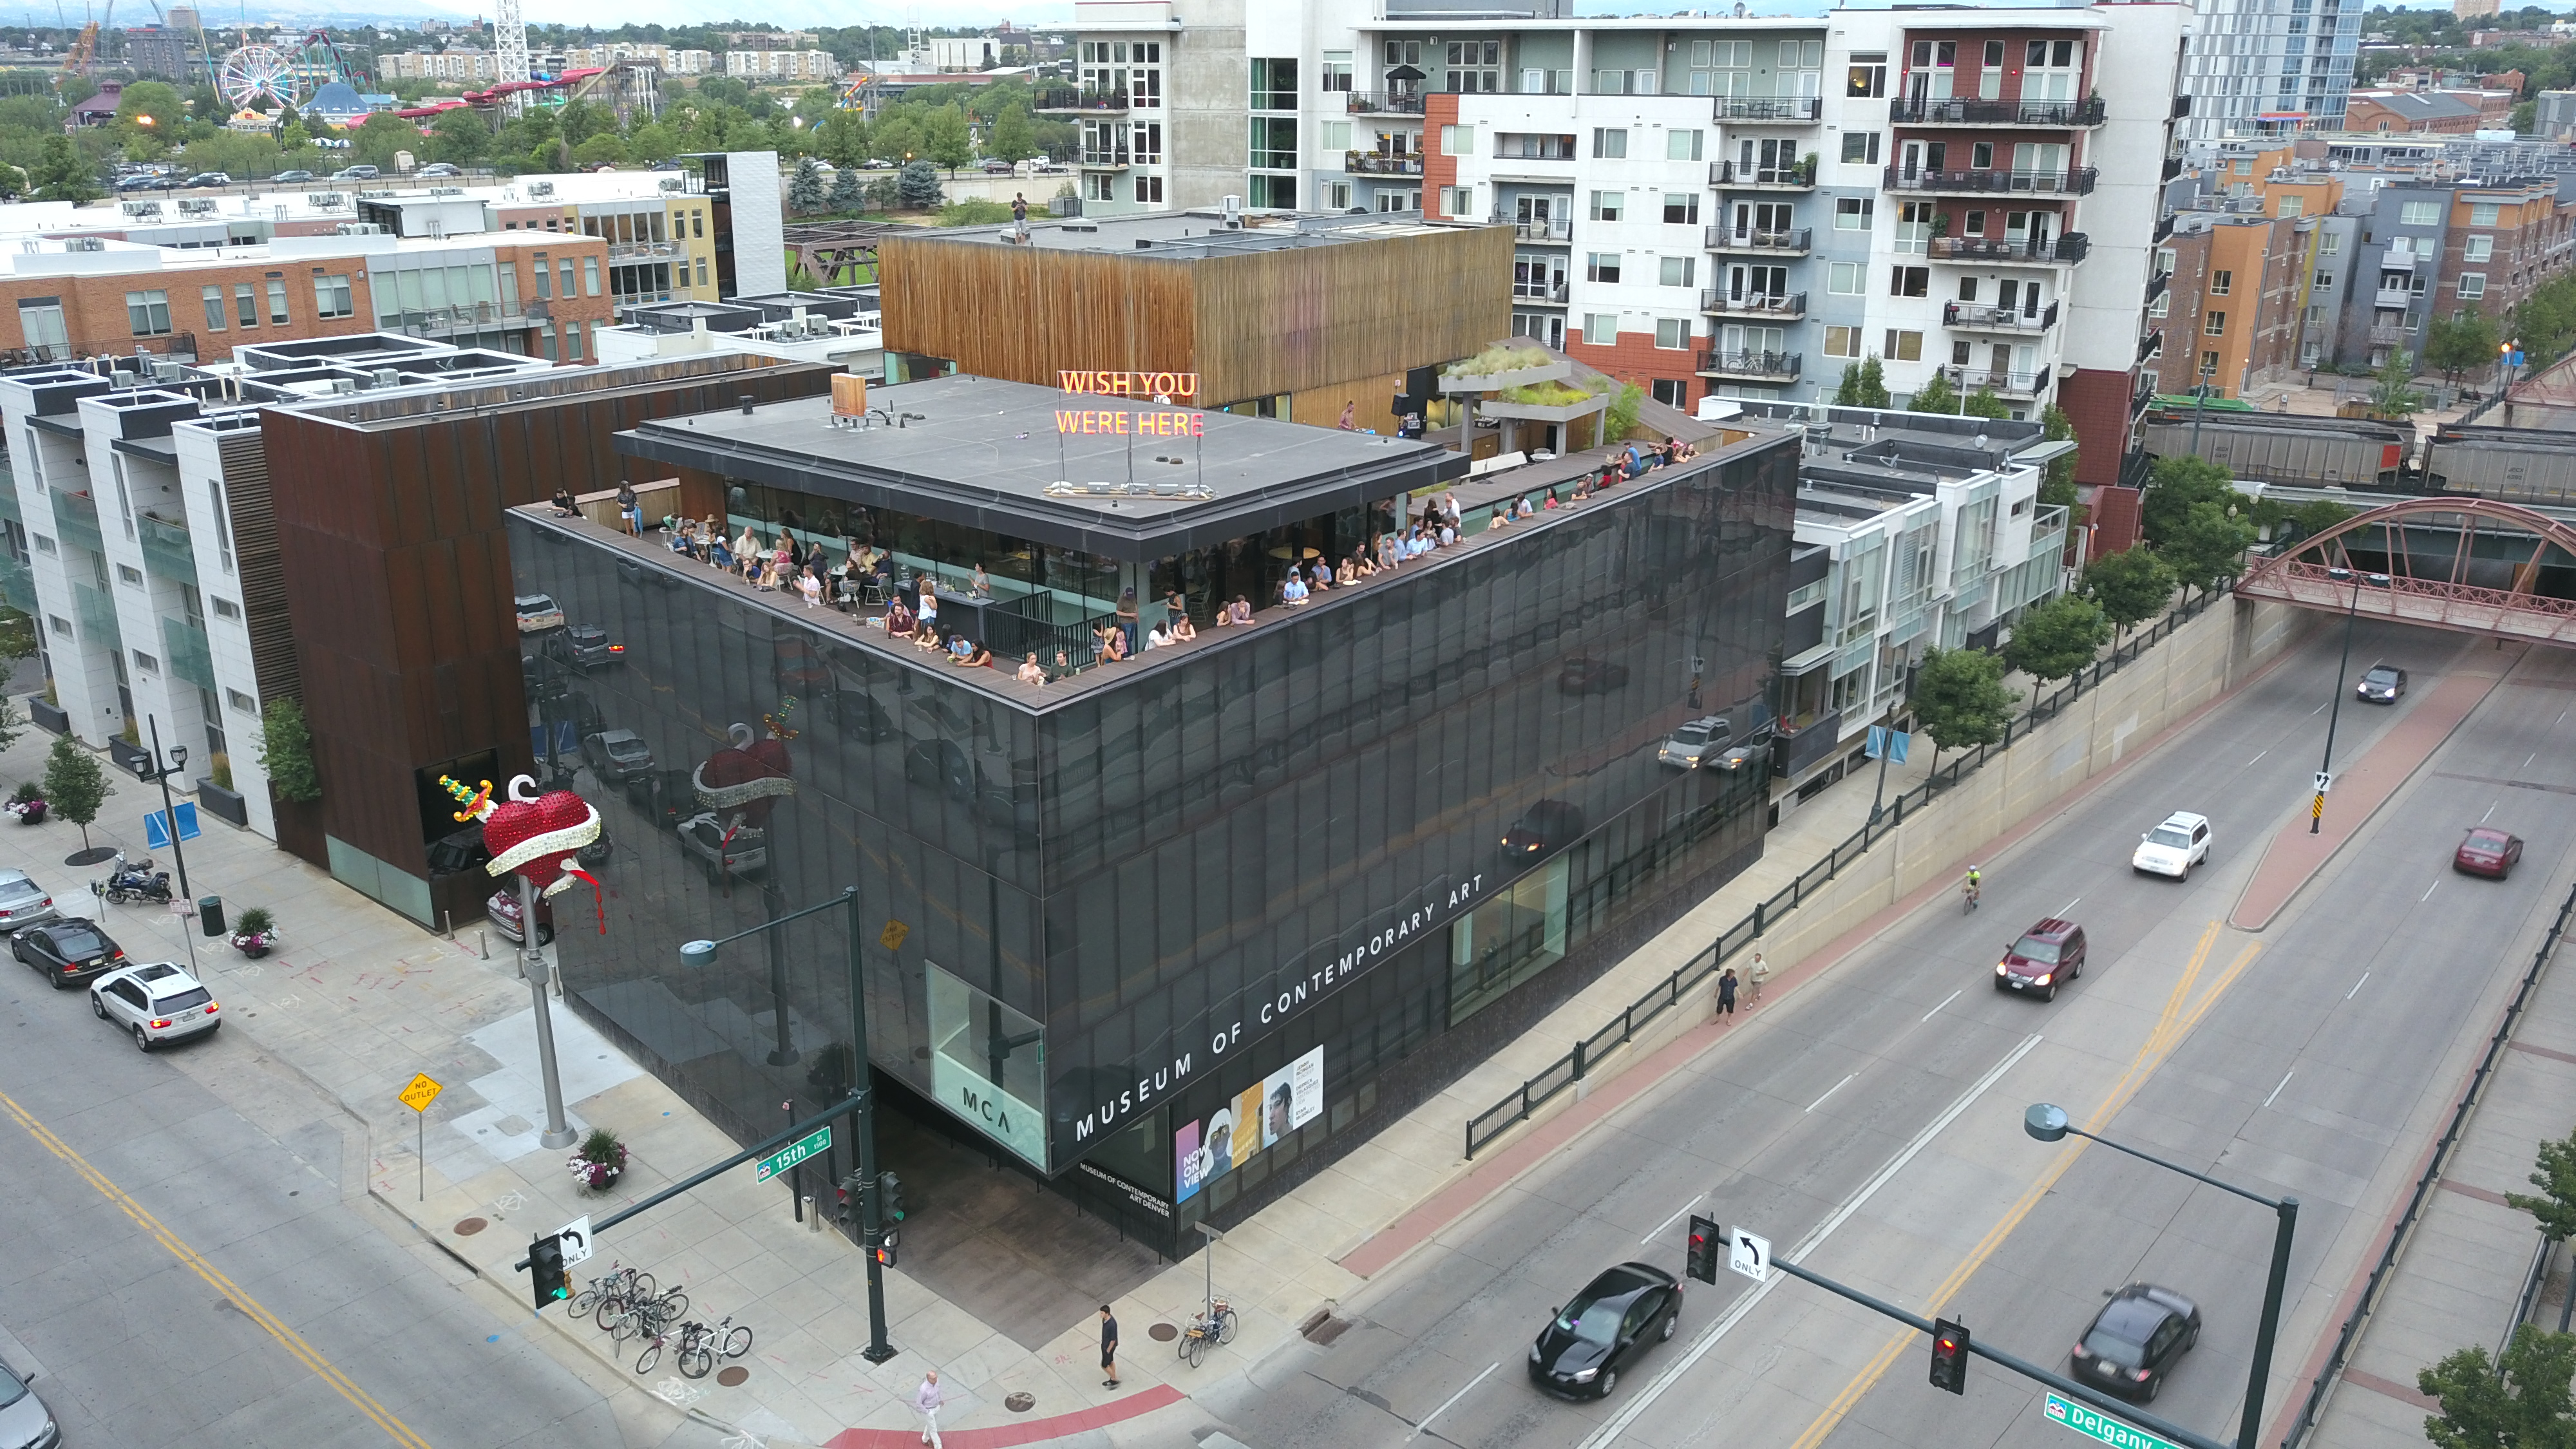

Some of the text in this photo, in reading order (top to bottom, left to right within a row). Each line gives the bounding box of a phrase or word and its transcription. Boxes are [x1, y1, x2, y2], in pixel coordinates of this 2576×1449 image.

[1061, 370, 1196, 397] WISH YOU
[1055, 410, 1204, 437] WERE HERE
[1077, 874, 1482, 1142] MUSEUM OF CONTEMPORARY ART
[404, 1088, 437, 1101] OUTLET
[963, 1086, 1010, 1133] MCA
[813, 1139, 826, 1150] 1500
[1184, 1143, 1209, 1168] NOW
[776, 1145, 806, 1169] 15th
[1184, 1159, 1199, 1178] ON
[1080, 1162, 1169, 1209] MUSEUM OF CONTEMPORARY
[1184, 1165, 1209, 1188] VIEW
[1130, 1193, 1170, 1218] ART DENVER
[562, 1248, 587, 1267] ONLY
[1734, 1260, 1761, 1277] ONLY
